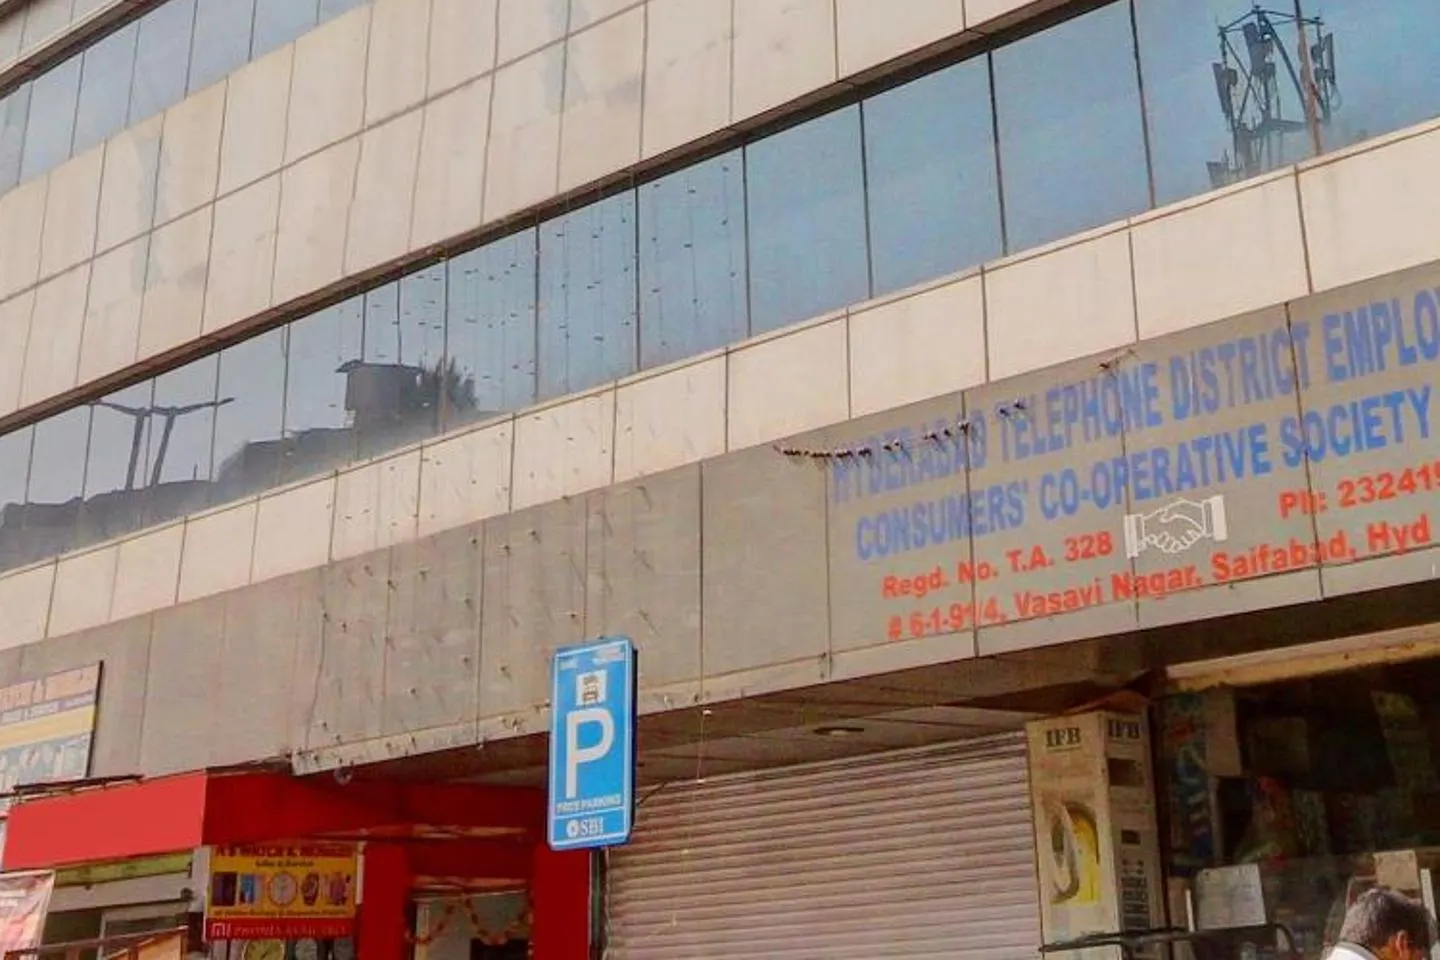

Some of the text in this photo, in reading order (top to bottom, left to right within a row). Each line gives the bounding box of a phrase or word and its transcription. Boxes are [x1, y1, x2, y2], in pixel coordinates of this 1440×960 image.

[994, 360, 1162, 462] TELEPHONE
[1169, 319, 1310, 421] DISTRICT
[1323, 286, 1440, 382] EMPLO
[855, 383, 1432, 561] CONSUMERS' CO-OPERATIVE SOCIETY
[882, 530, 1114, 599] Regd. No. T.A. 328
[1014, 576, 1104, 618] Vasavi
[1367, 513, 1432, 554] Hyd
[565, 707, 615, 799] P
[1045, 727, 1081, 749] IFB
